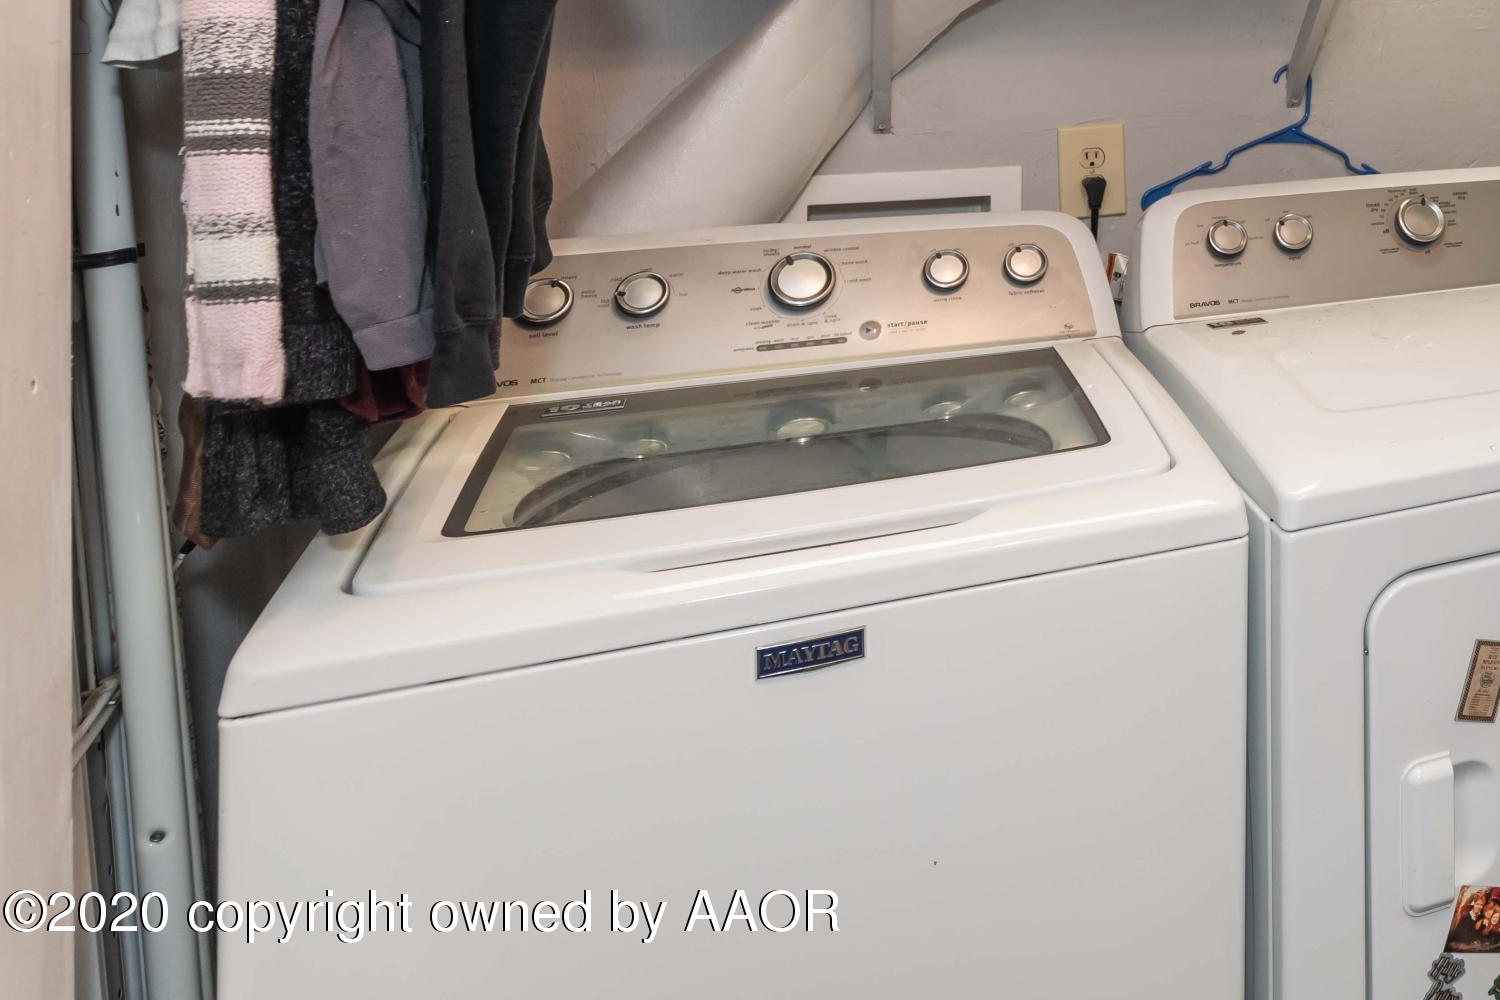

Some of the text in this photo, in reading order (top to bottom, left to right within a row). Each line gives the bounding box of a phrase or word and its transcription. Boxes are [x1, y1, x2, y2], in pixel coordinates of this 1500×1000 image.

[1190, 300, 1220, 308] BRAVOS
[643, 322, 661, 330] temp
[887, 319, 928, 329] start/pause
[542, 330, 559, 338] level
[763, 636, 859, 671] MAYTAG
